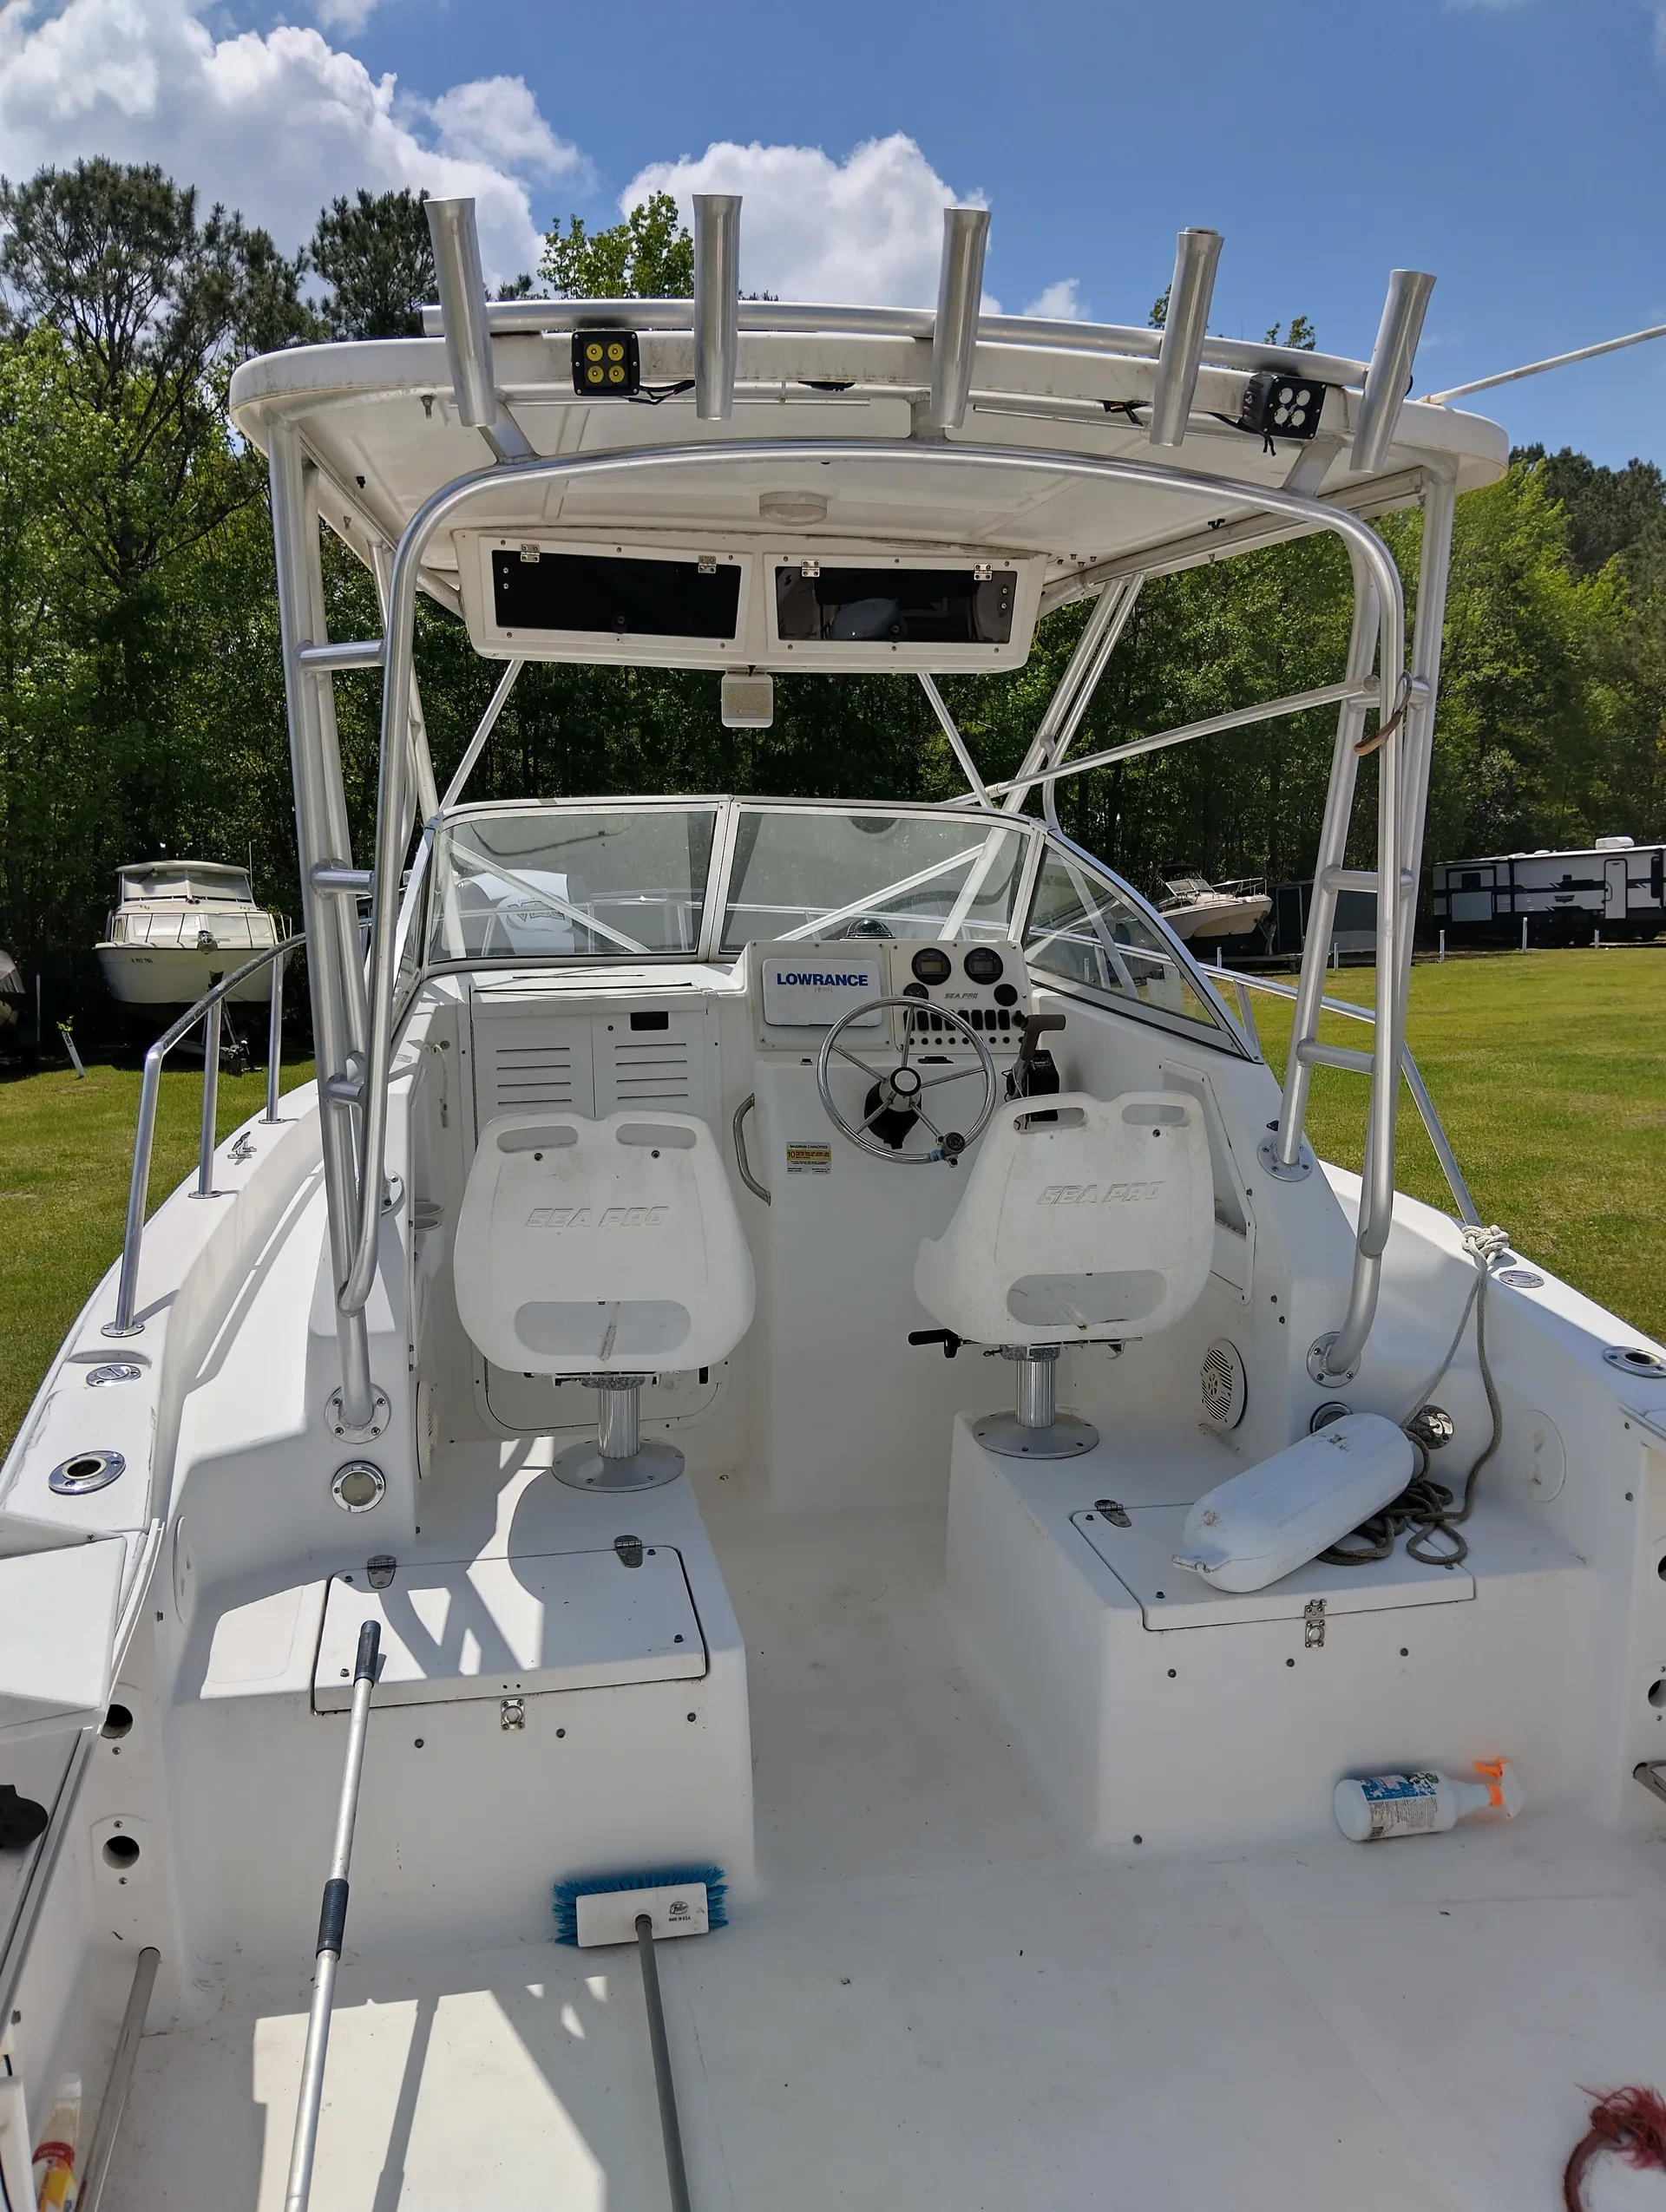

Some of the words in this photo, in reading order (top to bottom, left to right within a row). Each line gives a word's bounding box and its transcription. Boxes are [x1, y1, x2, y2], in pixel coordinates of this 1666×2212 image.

[777, 972, 869, 986] LOWRANCE
[1036, 1185, 1098, 1204] SEA
[1102, 1181, 1164, 1202] PRO
[525, 1207, 591, 1227] SEA
[597, 1206, 670, 1227] PRO
